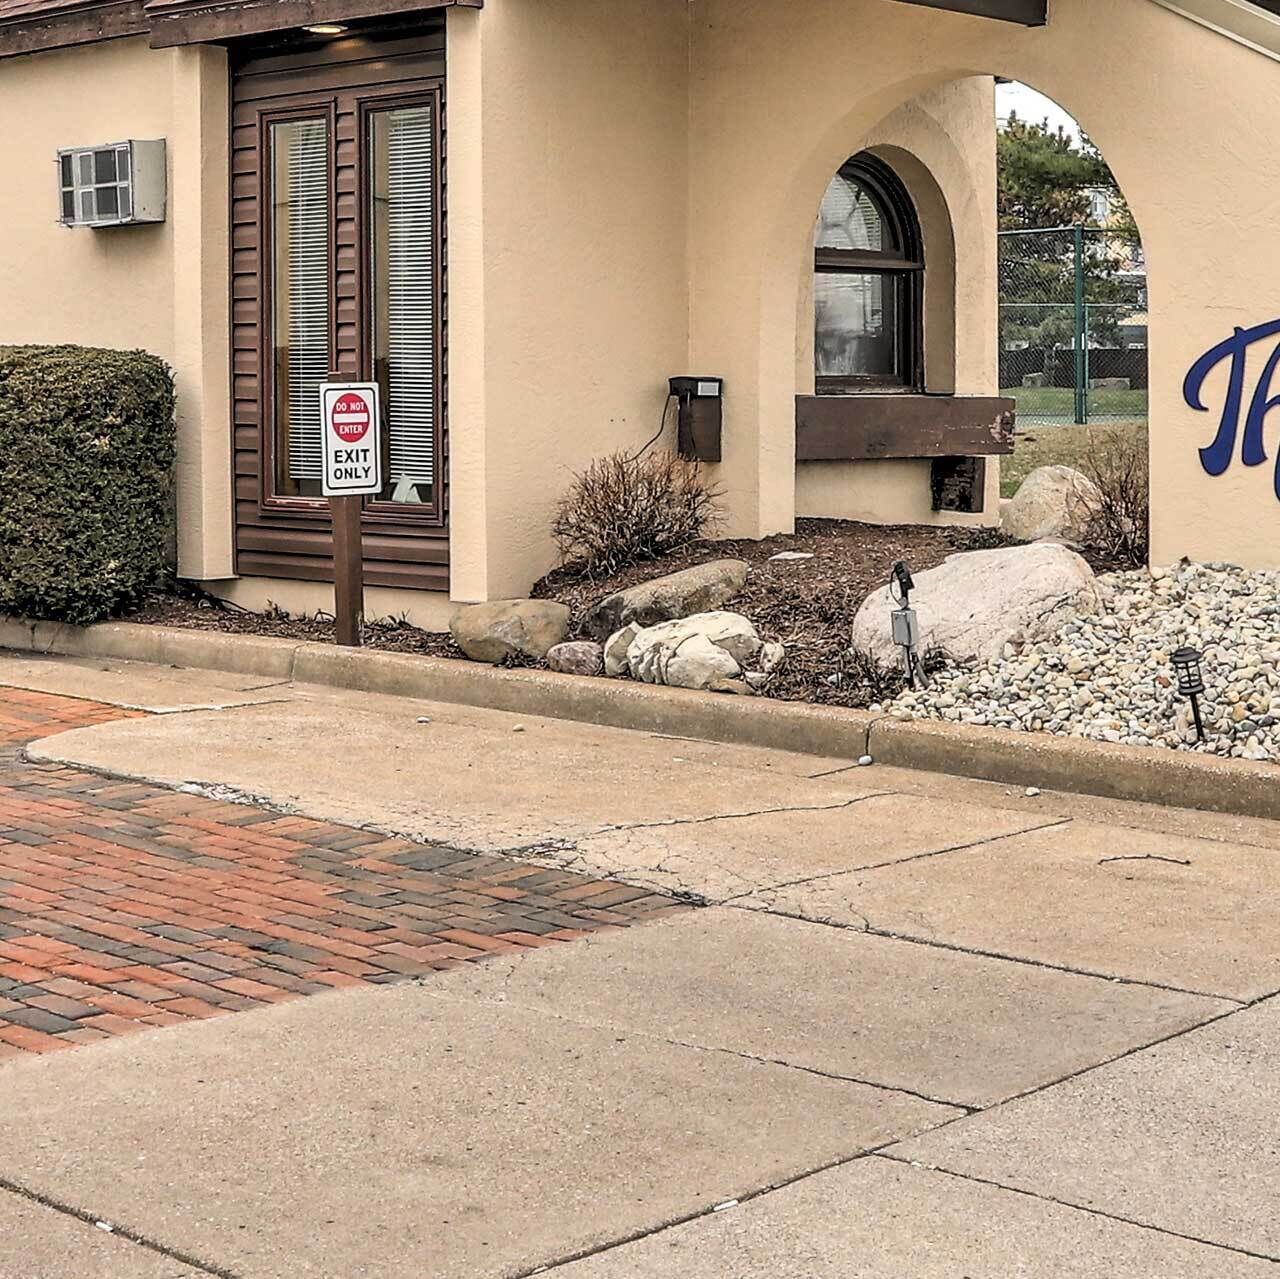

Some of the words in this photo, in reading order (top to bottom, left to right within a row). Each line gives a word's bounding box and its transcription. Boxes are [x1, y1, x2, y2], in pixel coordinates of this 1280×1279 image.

[336, 402, 347, 411] DO
[350, 402, 365, 410] NOT
[339, 425, 363, 434] ENTER
[334, 449, 370, 463] EXIT
[333, 466, 371, 480] ONLY
